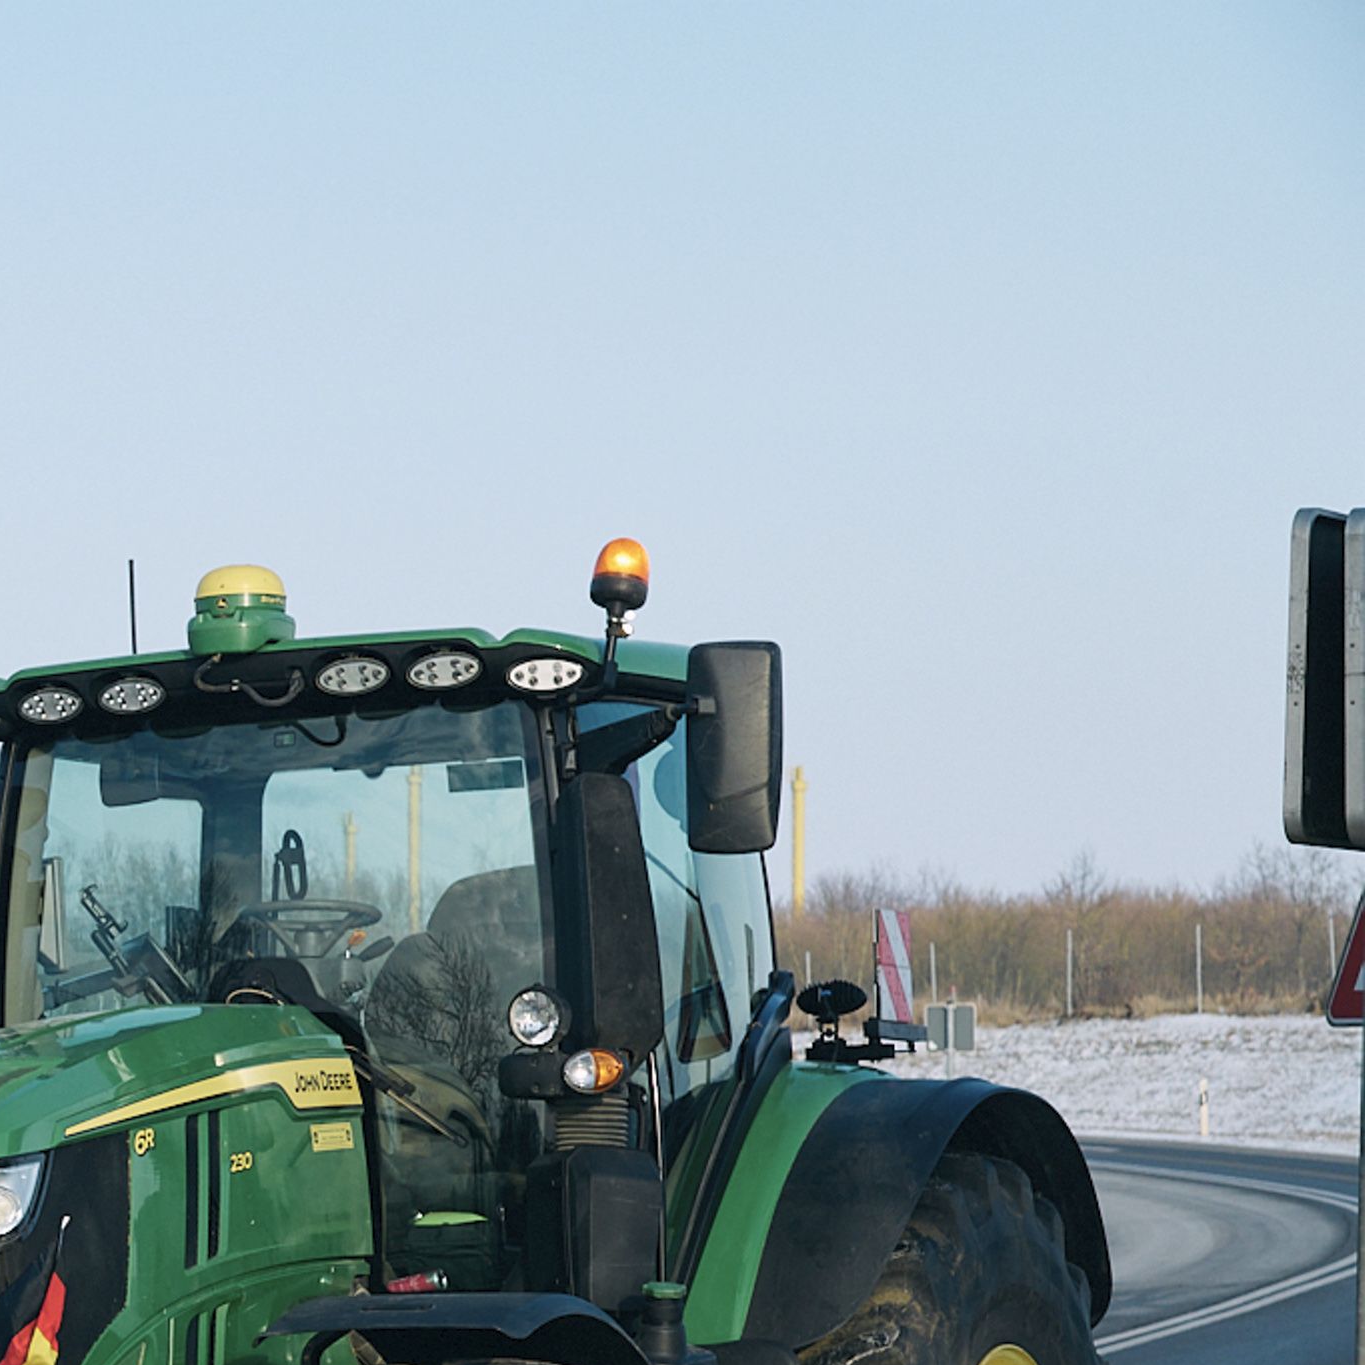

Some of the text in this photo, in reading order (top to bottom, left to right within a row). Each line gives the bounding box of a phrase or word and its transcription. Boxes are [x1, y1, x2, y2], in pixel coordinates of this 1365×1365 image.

[295, 1070, 353, 1093] JOHN DEERE
[134, 1128, 155, 1156] 6R
[229, 1152, 254, 1174] 230
